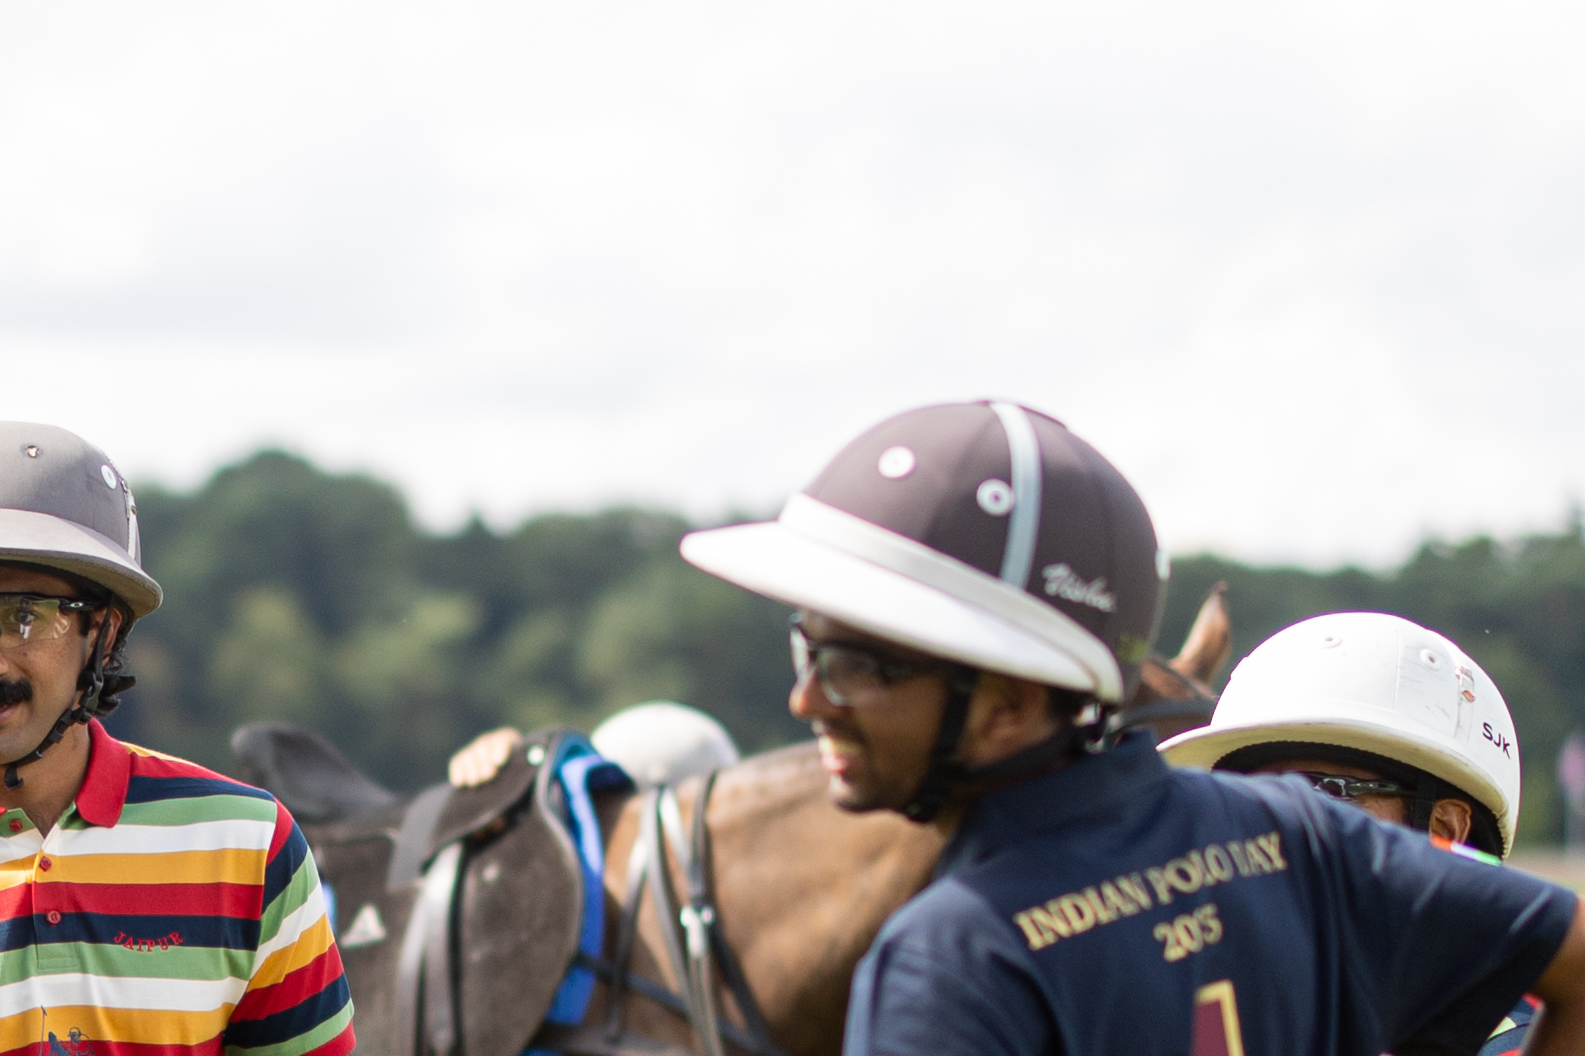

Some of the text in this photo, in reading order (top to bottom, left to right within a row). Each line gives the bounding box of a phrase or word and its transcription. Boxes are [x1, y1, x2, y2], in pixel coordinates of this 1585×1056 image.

[1482, 722, 1511, 759] SJK
[1013, 887, 1153, 950] INDIAN
[1145, 844, 1234, 906] POLO
[113, 930, 184, 953] JAIPUR
